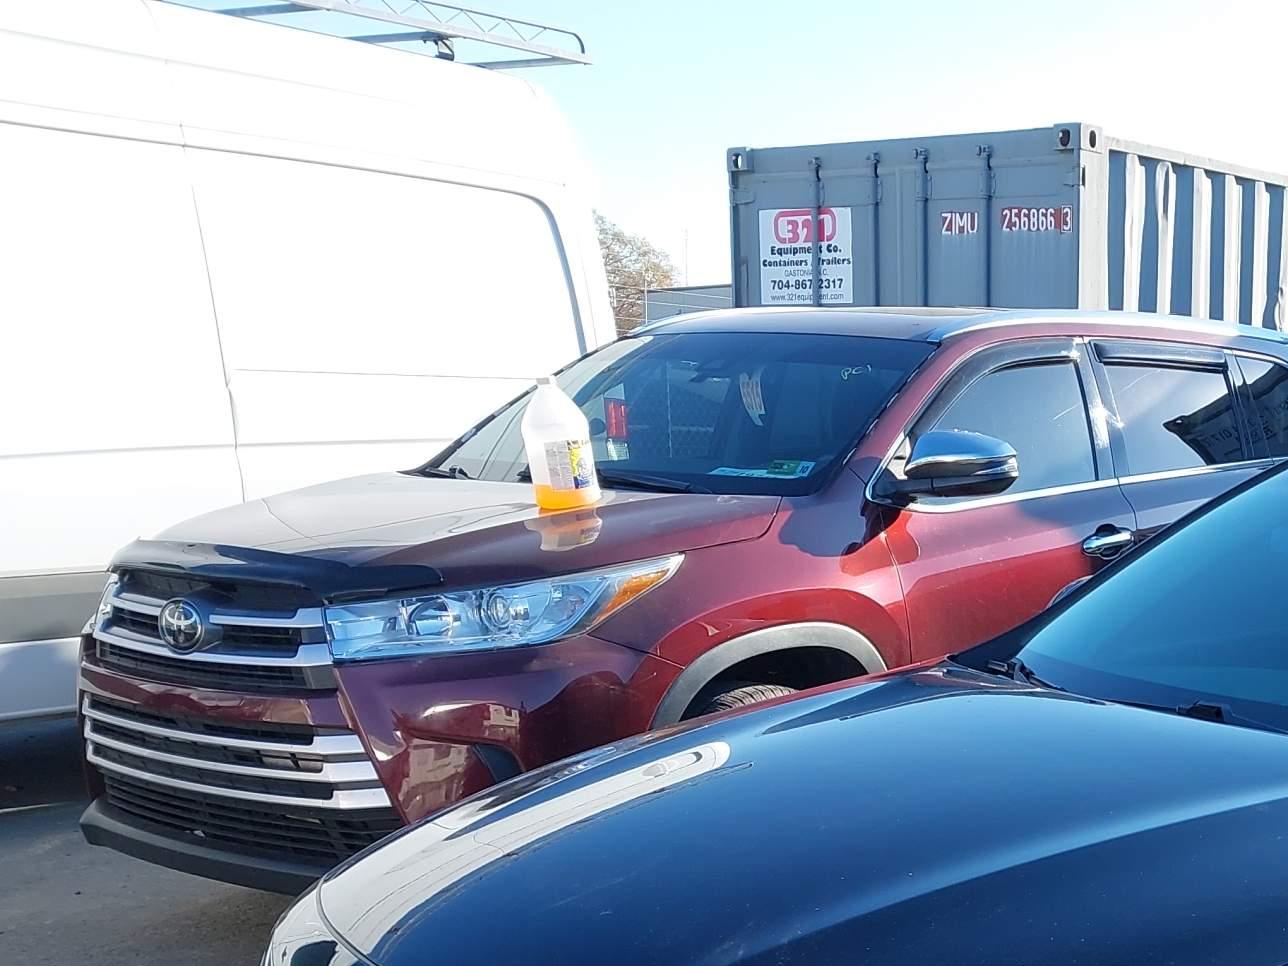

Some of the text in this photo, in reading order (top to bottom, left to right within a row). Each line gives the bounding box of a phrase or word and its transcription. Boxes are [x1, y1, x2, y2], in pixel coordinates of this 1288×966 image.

[941, 211, 978, 235] ZIMU
[1002, 208, 1055, 232] 256866
[770, 244, 842, 257] Equipmet Co.
[762, 259, 808, 267] Containers
[771, 279, 843, 290] 704-8672317
